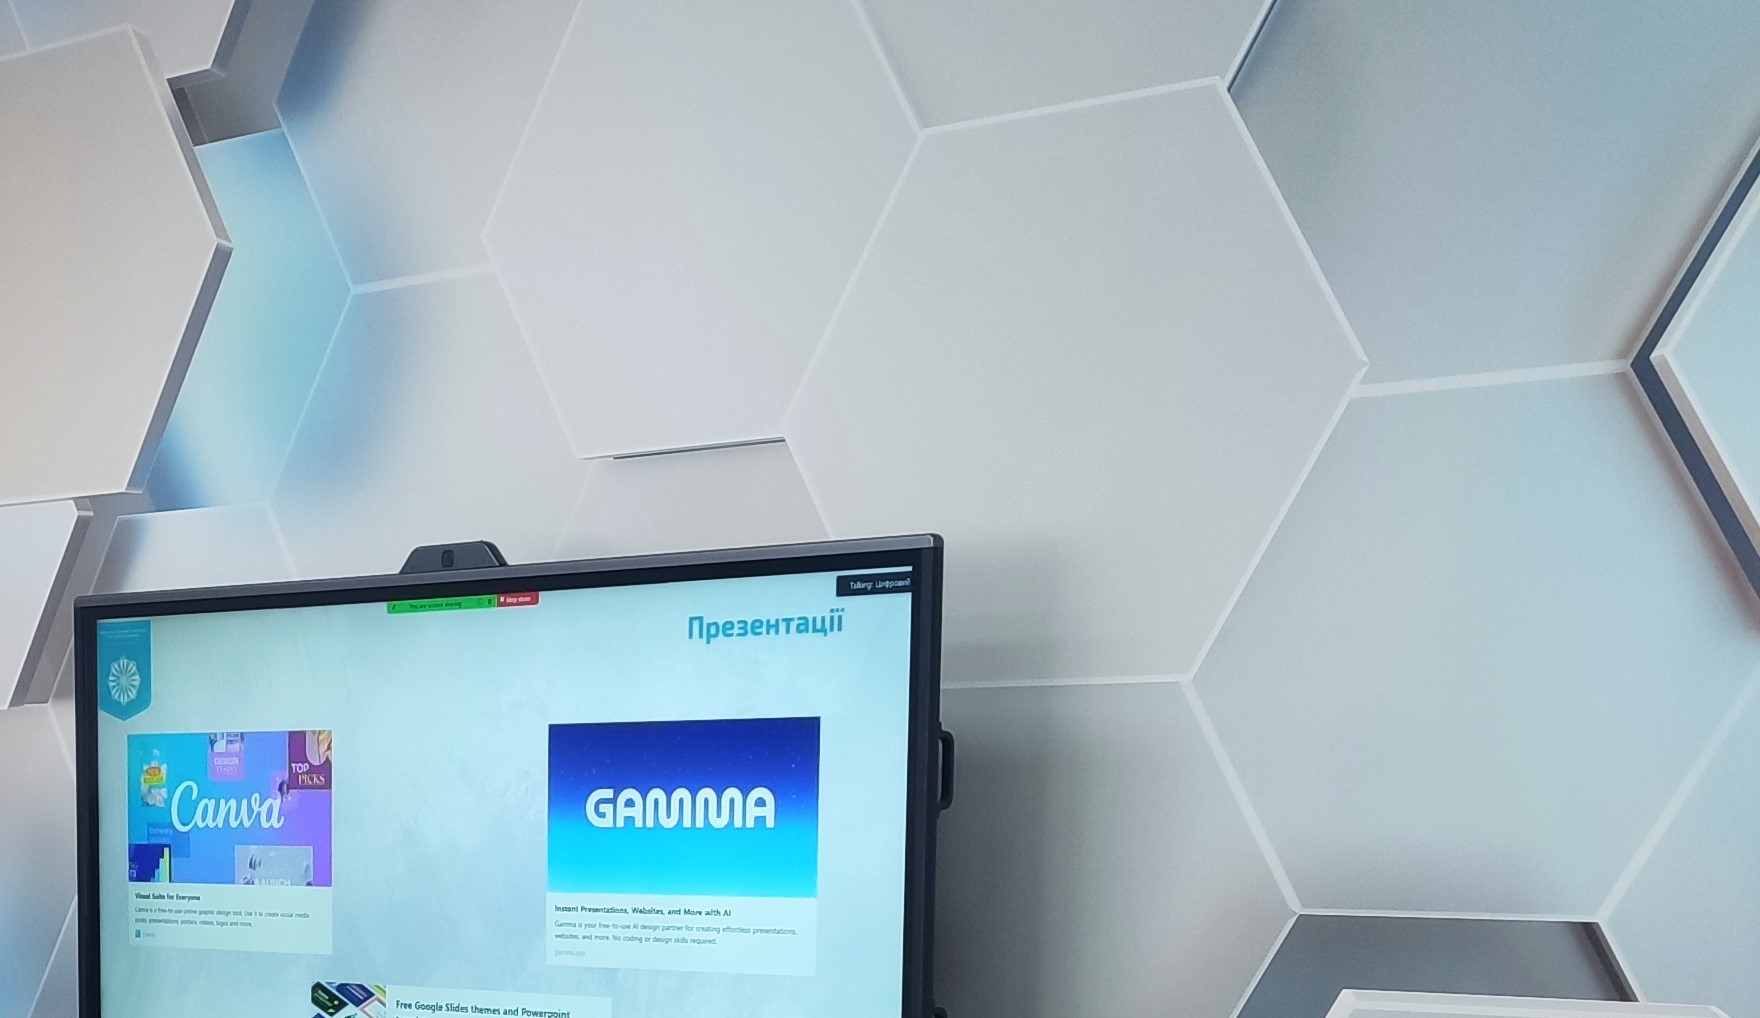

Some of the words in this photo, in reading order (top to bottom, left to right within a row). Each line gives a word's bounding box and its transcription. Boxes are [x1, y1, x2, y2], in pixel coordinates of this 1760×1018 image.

[688, 608, 845, 644] Презентації
[214, 757, 239, 766] DESIGN
[291, 762, 310, 774] TOP
[298, 773, 325, 786] PICKS
[171, 780, 285, 832] Canva
[585, 786, 775, 829] GAMMA
[176, 893, 200, 903] Everyone
[580, 905, 629, 914] Presentations,
[631, 907, 665, 915] Websites,
[683, 908, 702, 916] More
[599, 922, 631, 930] free-to-use
[640, 923, 660, 932] design
[696, 926, 721, 934] creating
[722, 926, 751, 934] effortless
[623, 935, 643, 943] coding
[652, 936, 672, 944] design
[396, 1000, 412, 1009] Free
[414, 1001, 443, 1013] Google
[445, 1003, 468, 1013] Slides
[471, 1005, 501, 1015] themes
[503, 1007, 518, 1016] and
